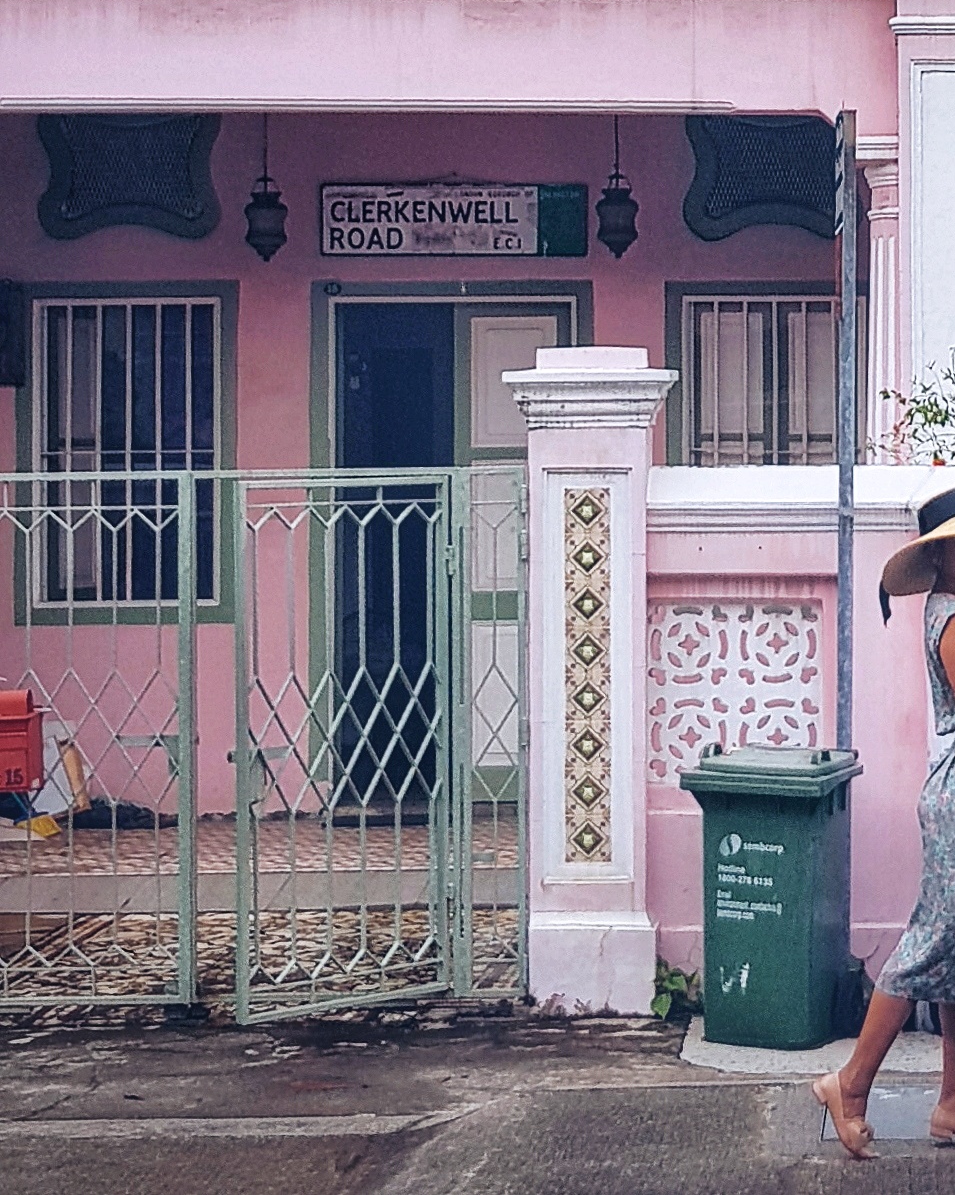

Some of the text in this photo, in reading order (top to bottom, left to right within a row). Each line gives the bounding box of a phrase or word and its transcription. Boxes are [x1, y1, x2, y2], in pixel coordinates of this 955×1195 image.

[329, 200, 519, 224] CLERKENWELL
[328, 226, 404, 250] ROAD
[5, 767, 24, 785] 15
